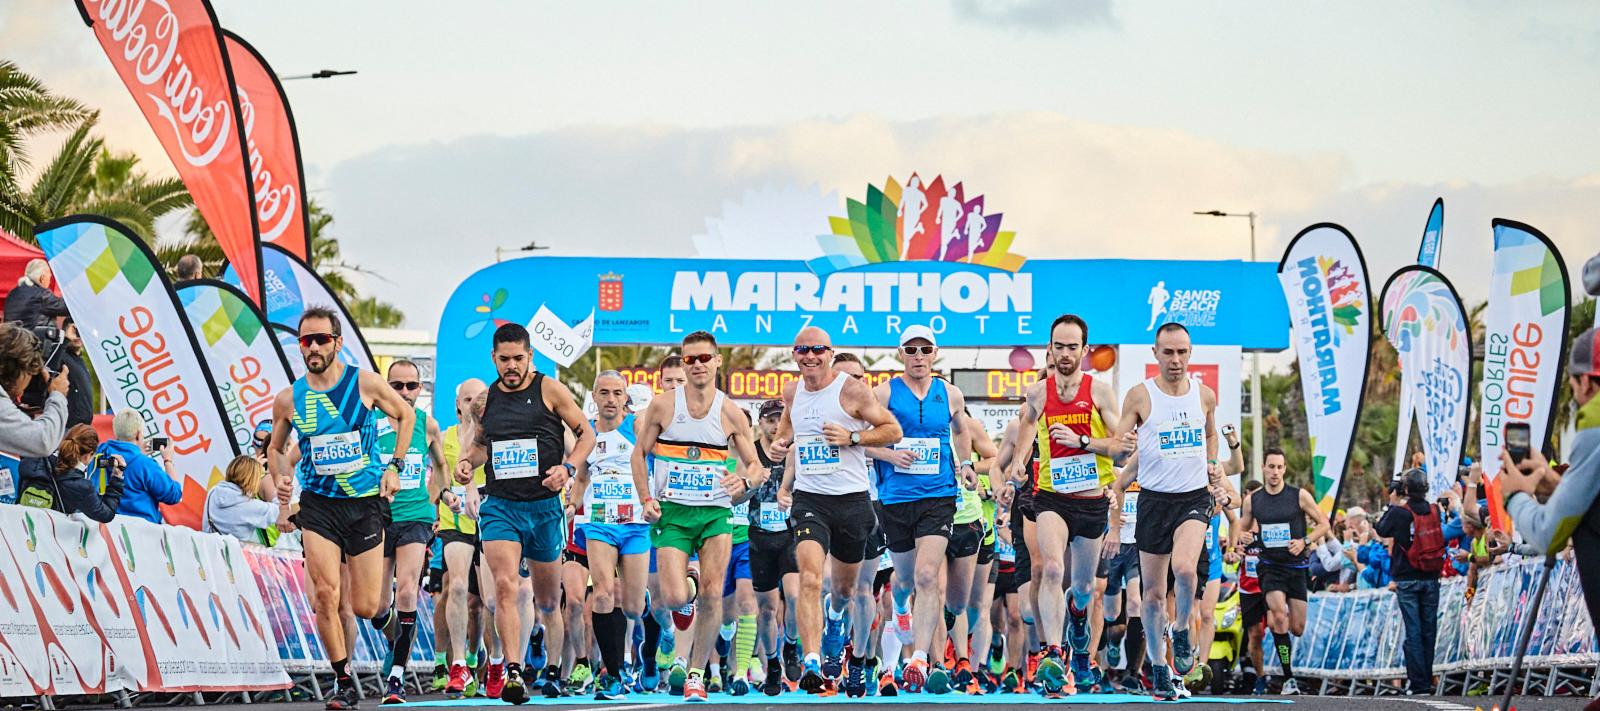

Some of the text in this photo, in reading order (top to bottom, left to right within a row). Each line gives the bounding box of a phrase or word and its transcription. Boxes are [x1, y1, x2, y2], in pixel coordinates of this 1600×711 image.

[669, 270, 1033, 313] MARATHON
[1173, 289, 1222, 301] SANDS
[1169, 300, 1218, 311] BEACH
[669, 314, 1033, 334] LANZAROTE
[534, 321, 574, 358] 03:30
[1047, 413, 1090, 425] NEWCASTLE
[1170, 430, 1196, 444] 4471
[322, 445, 353, 461] 4663
[501, 450, 528, 464] 4472
[803, 446, 830, 459] 4143
[678, 473, 707, 486] 4463
[1060, 465, 1089, 480] 4296
[600, 483, 624, 495] 4053
